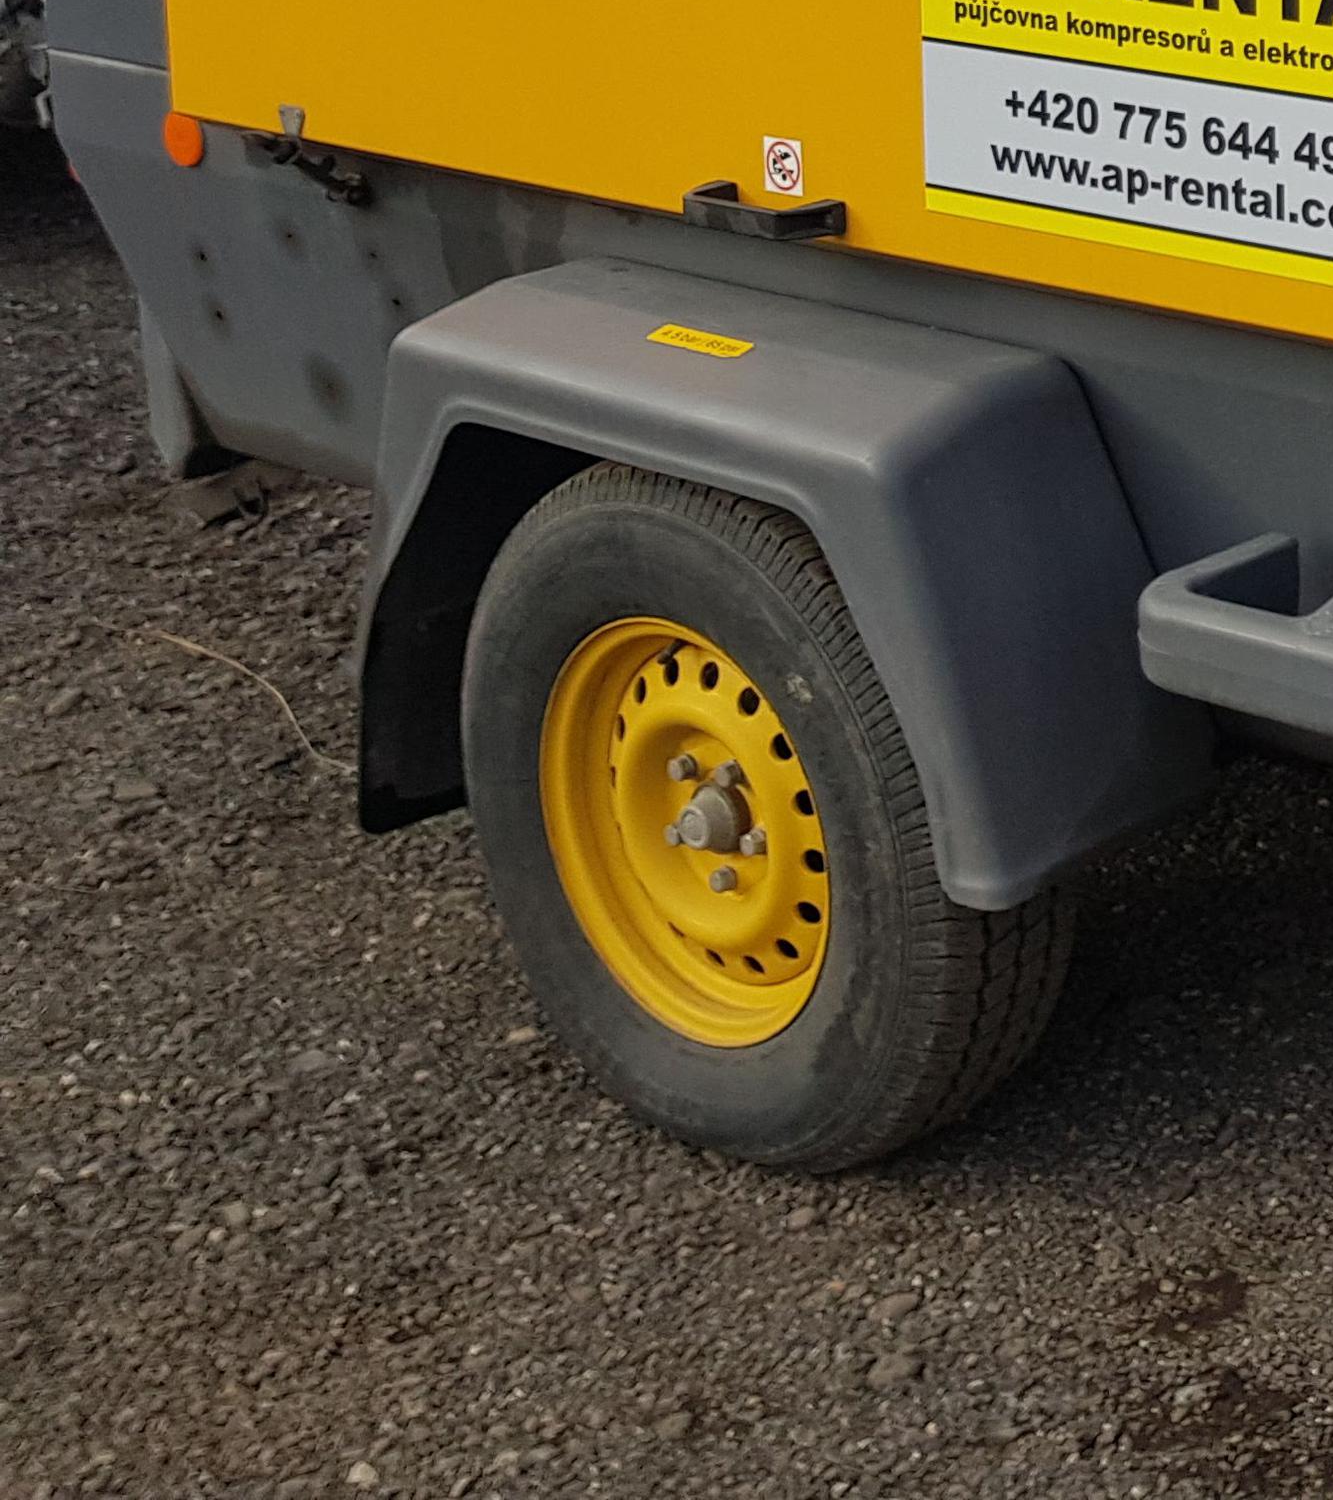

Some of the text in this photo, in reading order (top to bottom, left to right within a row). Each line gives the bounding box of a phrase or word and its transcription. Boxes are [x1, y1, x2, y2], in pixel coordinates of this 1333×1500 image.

[1067, 11, 1211, 54] kompresorů
[1219, 39, 1234, 57] a
[1006, 90, 1098, 135] +420
[1113, 102, 1187, 148] 775
[1203, 118, 1279, 164] 644
